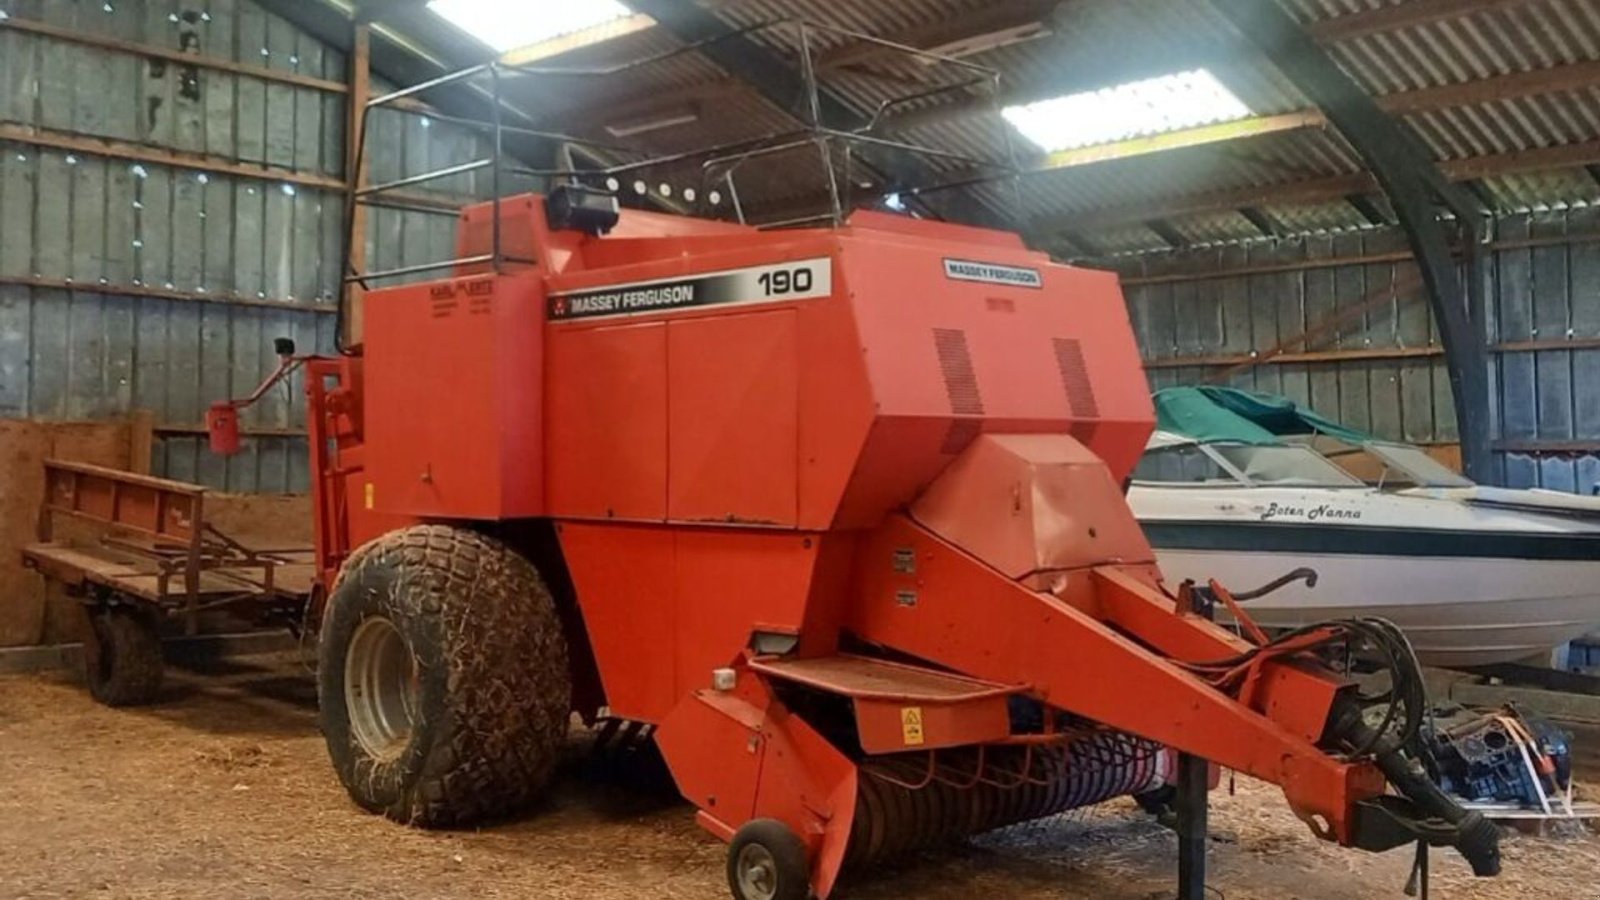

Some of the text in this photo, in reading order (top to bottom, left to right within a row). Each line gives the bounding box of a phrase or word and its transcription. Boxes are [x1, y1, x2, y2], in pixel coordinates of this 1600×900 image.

[570, 267, 814, 315] MASSEY FERGUSON 190
[1307, 504, 1362, 521] Nanna
